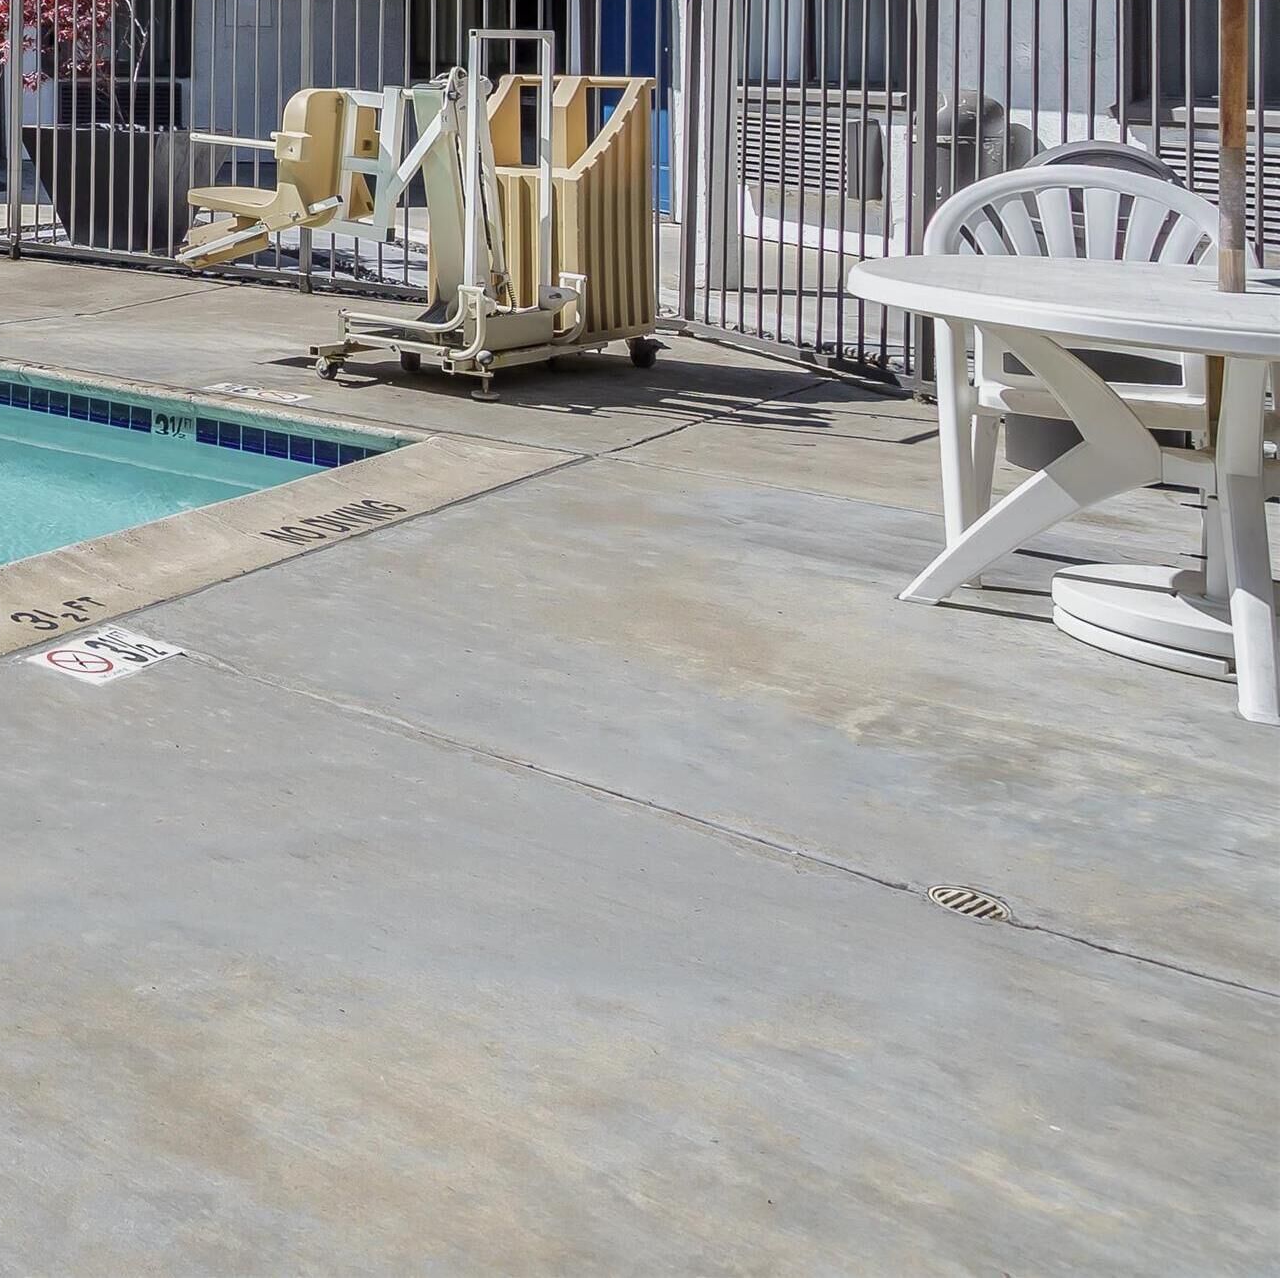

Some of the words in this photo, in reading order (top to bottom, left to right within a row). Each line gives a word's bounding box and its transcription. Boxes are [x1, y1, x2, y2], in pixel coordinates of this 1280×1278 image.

[260, 526, 326, 545] NO
[299, 499, 407, 533] DIVING
[63, 597, 106, 612] FT
